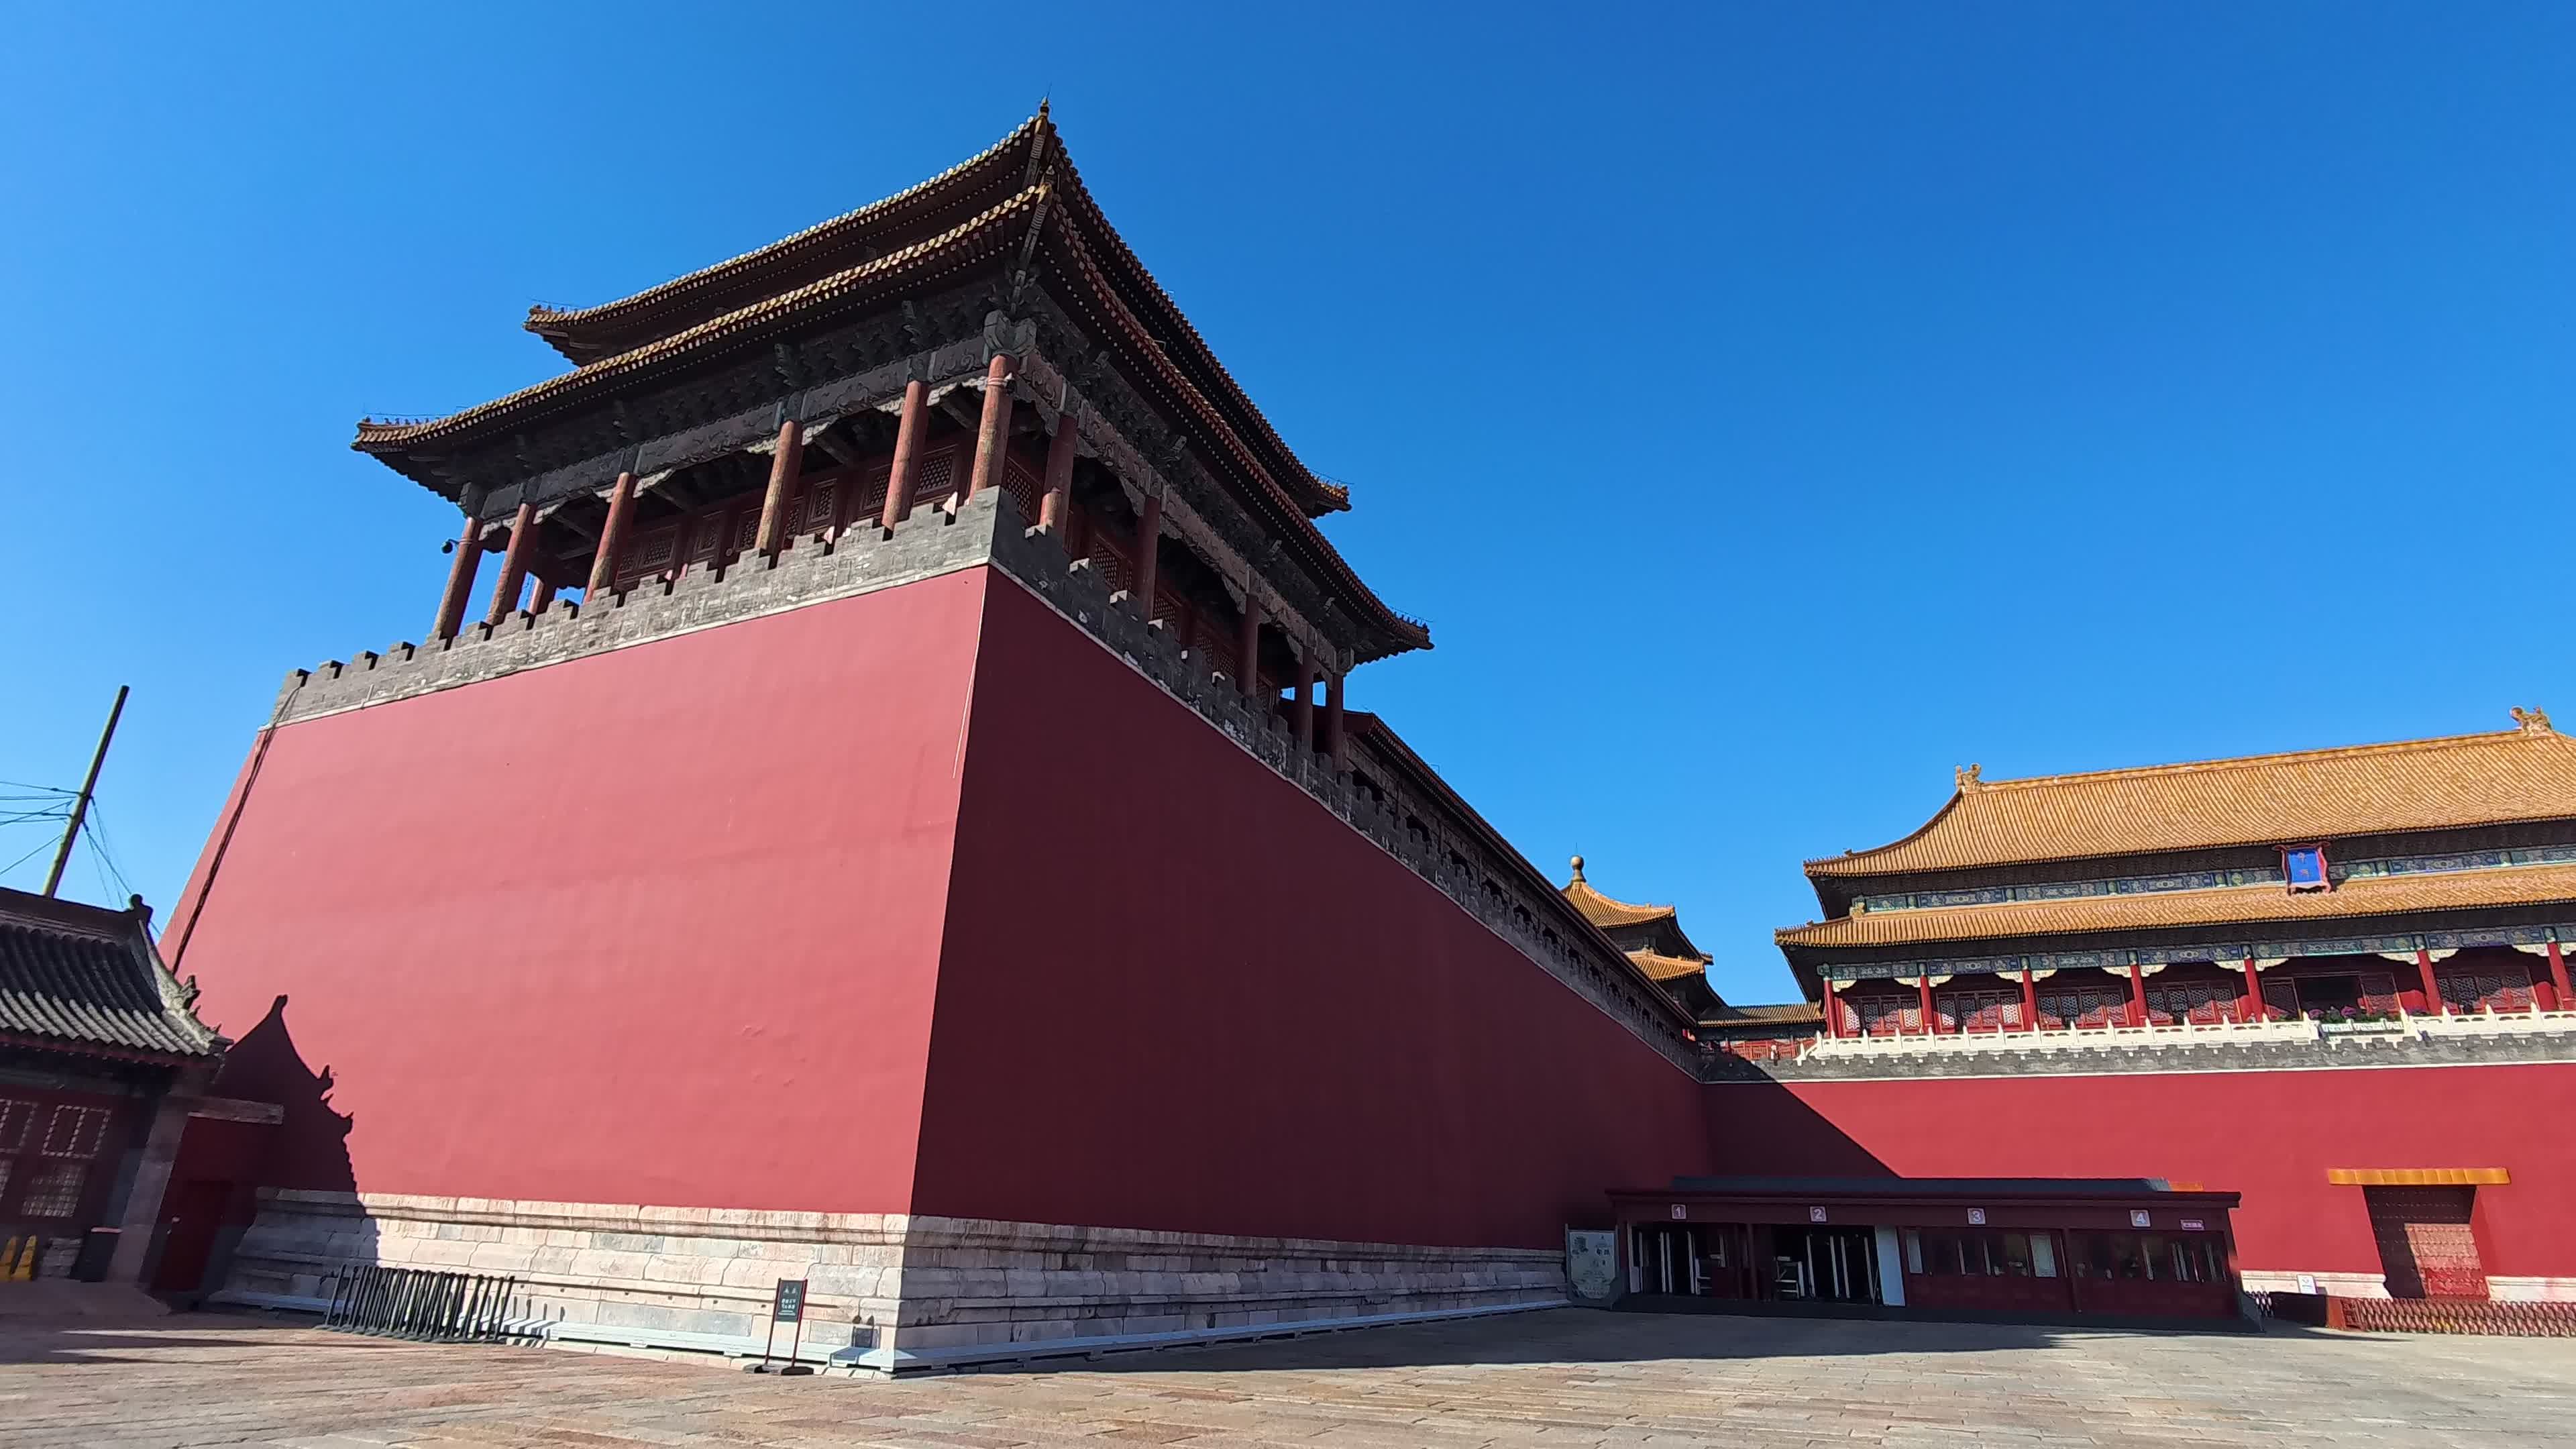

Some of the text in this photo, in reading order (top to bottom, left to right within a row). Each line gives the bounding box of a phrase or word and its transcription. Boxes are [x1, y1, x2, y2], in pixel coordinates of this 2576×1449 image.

[1814, 1208, 1822, 1220] 2
[1972, 1210, 1981, 1222] 3
[2136, 1212, 2146, 1224] 4
